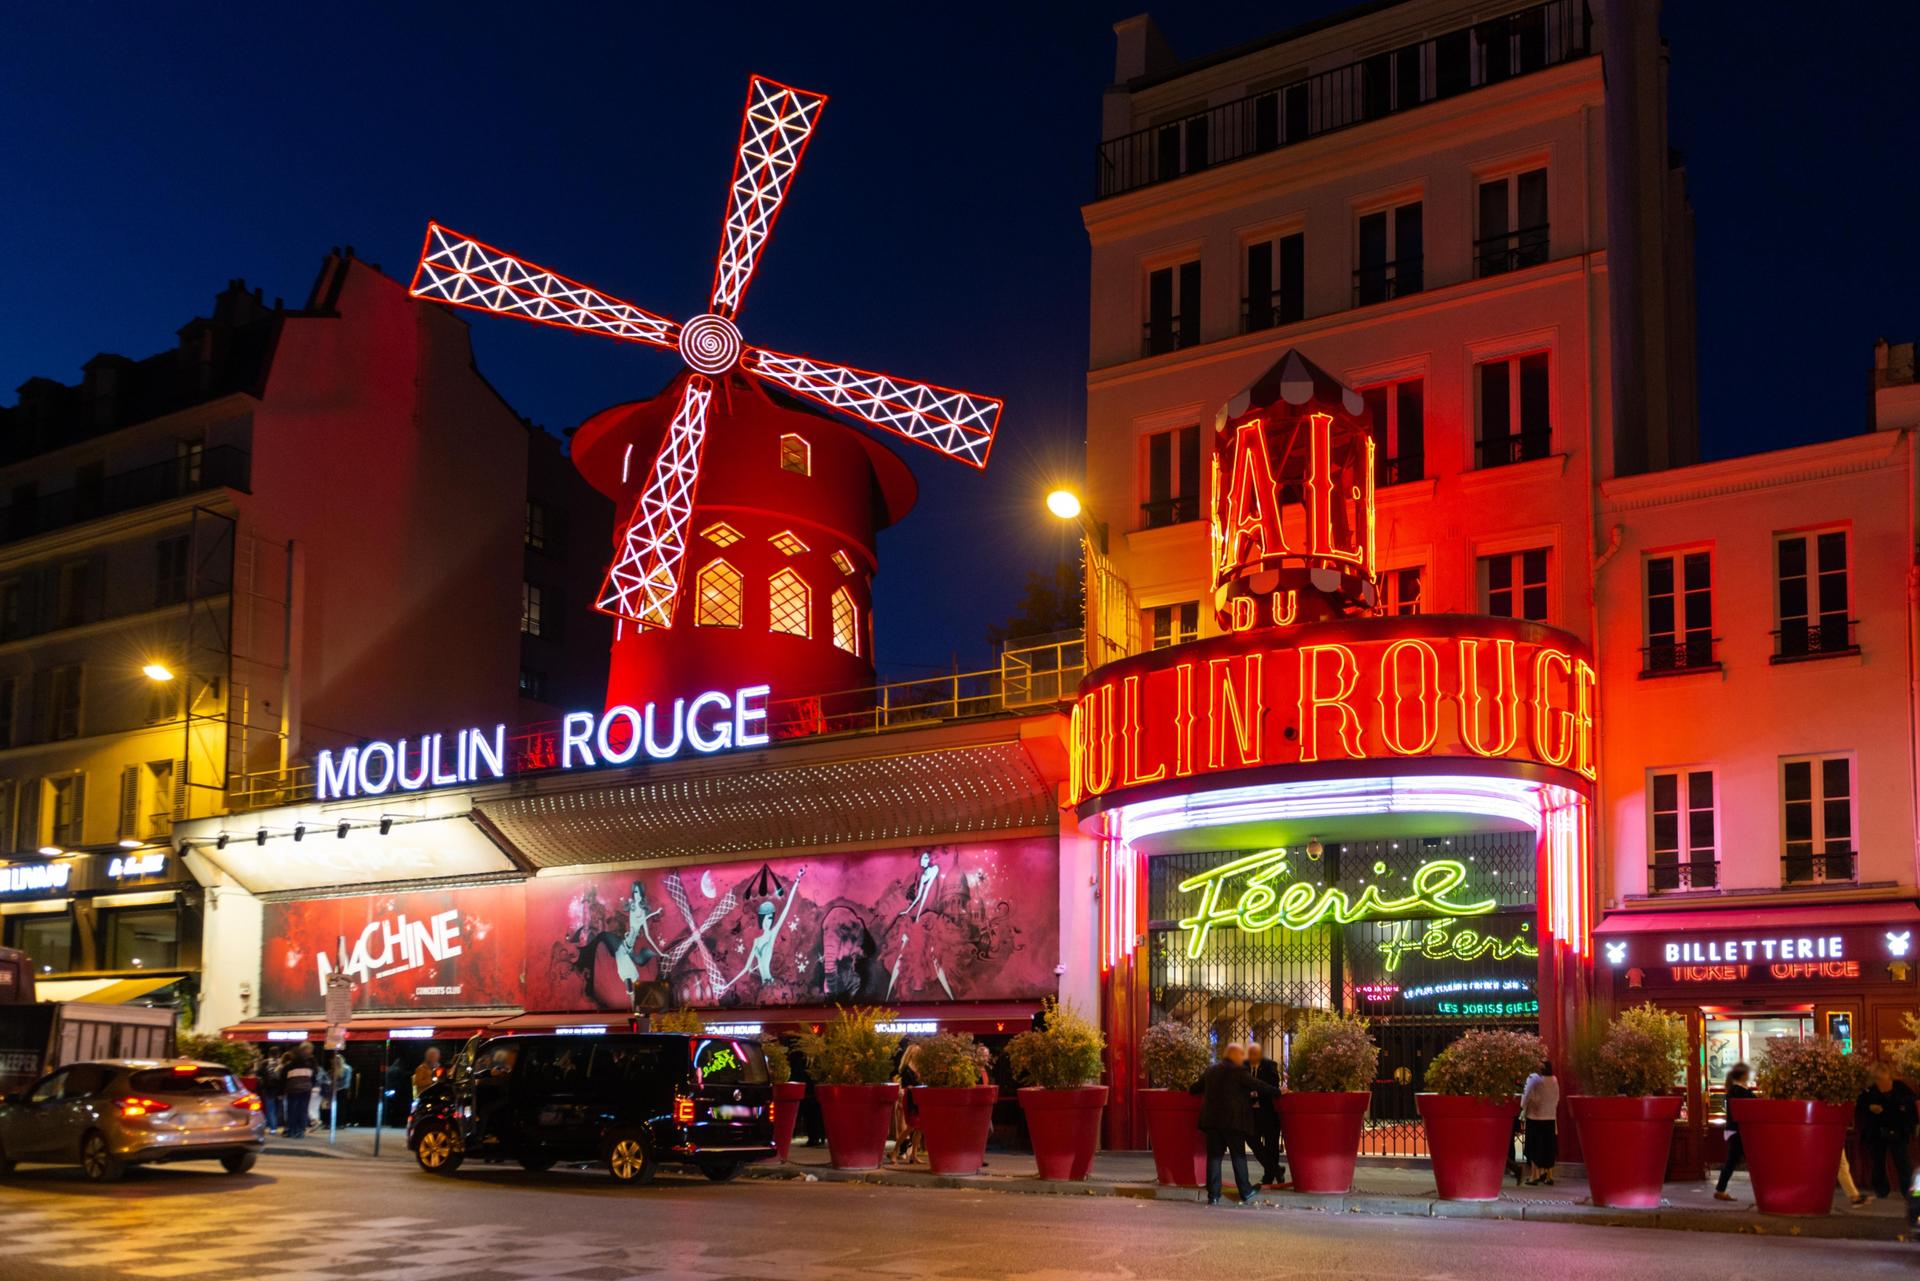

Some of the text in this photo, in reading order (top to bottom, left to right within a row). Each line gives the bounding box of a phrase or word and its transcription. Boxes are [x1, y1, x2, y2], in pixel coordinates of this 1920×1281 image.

[1211, 411, 1363, 582] AL
[1231, 590, 1297, 632] DU
[316, 684, 770, 800] MOULIN ROUGE
[1070, 638, 1597, 805] OULIN ROUGE
[1178, 847, 1497, 959] Féerie
[1377, 917, 1539, 972] Féeri
[1665, 936, 1843, 963] BILLETTERIE
[1671, 960, 1860, 982] TICKET OFFICE
[1438, 1002, 1458, 1014] LES
[1505, 1000, 1539, 1014] GIRLS
